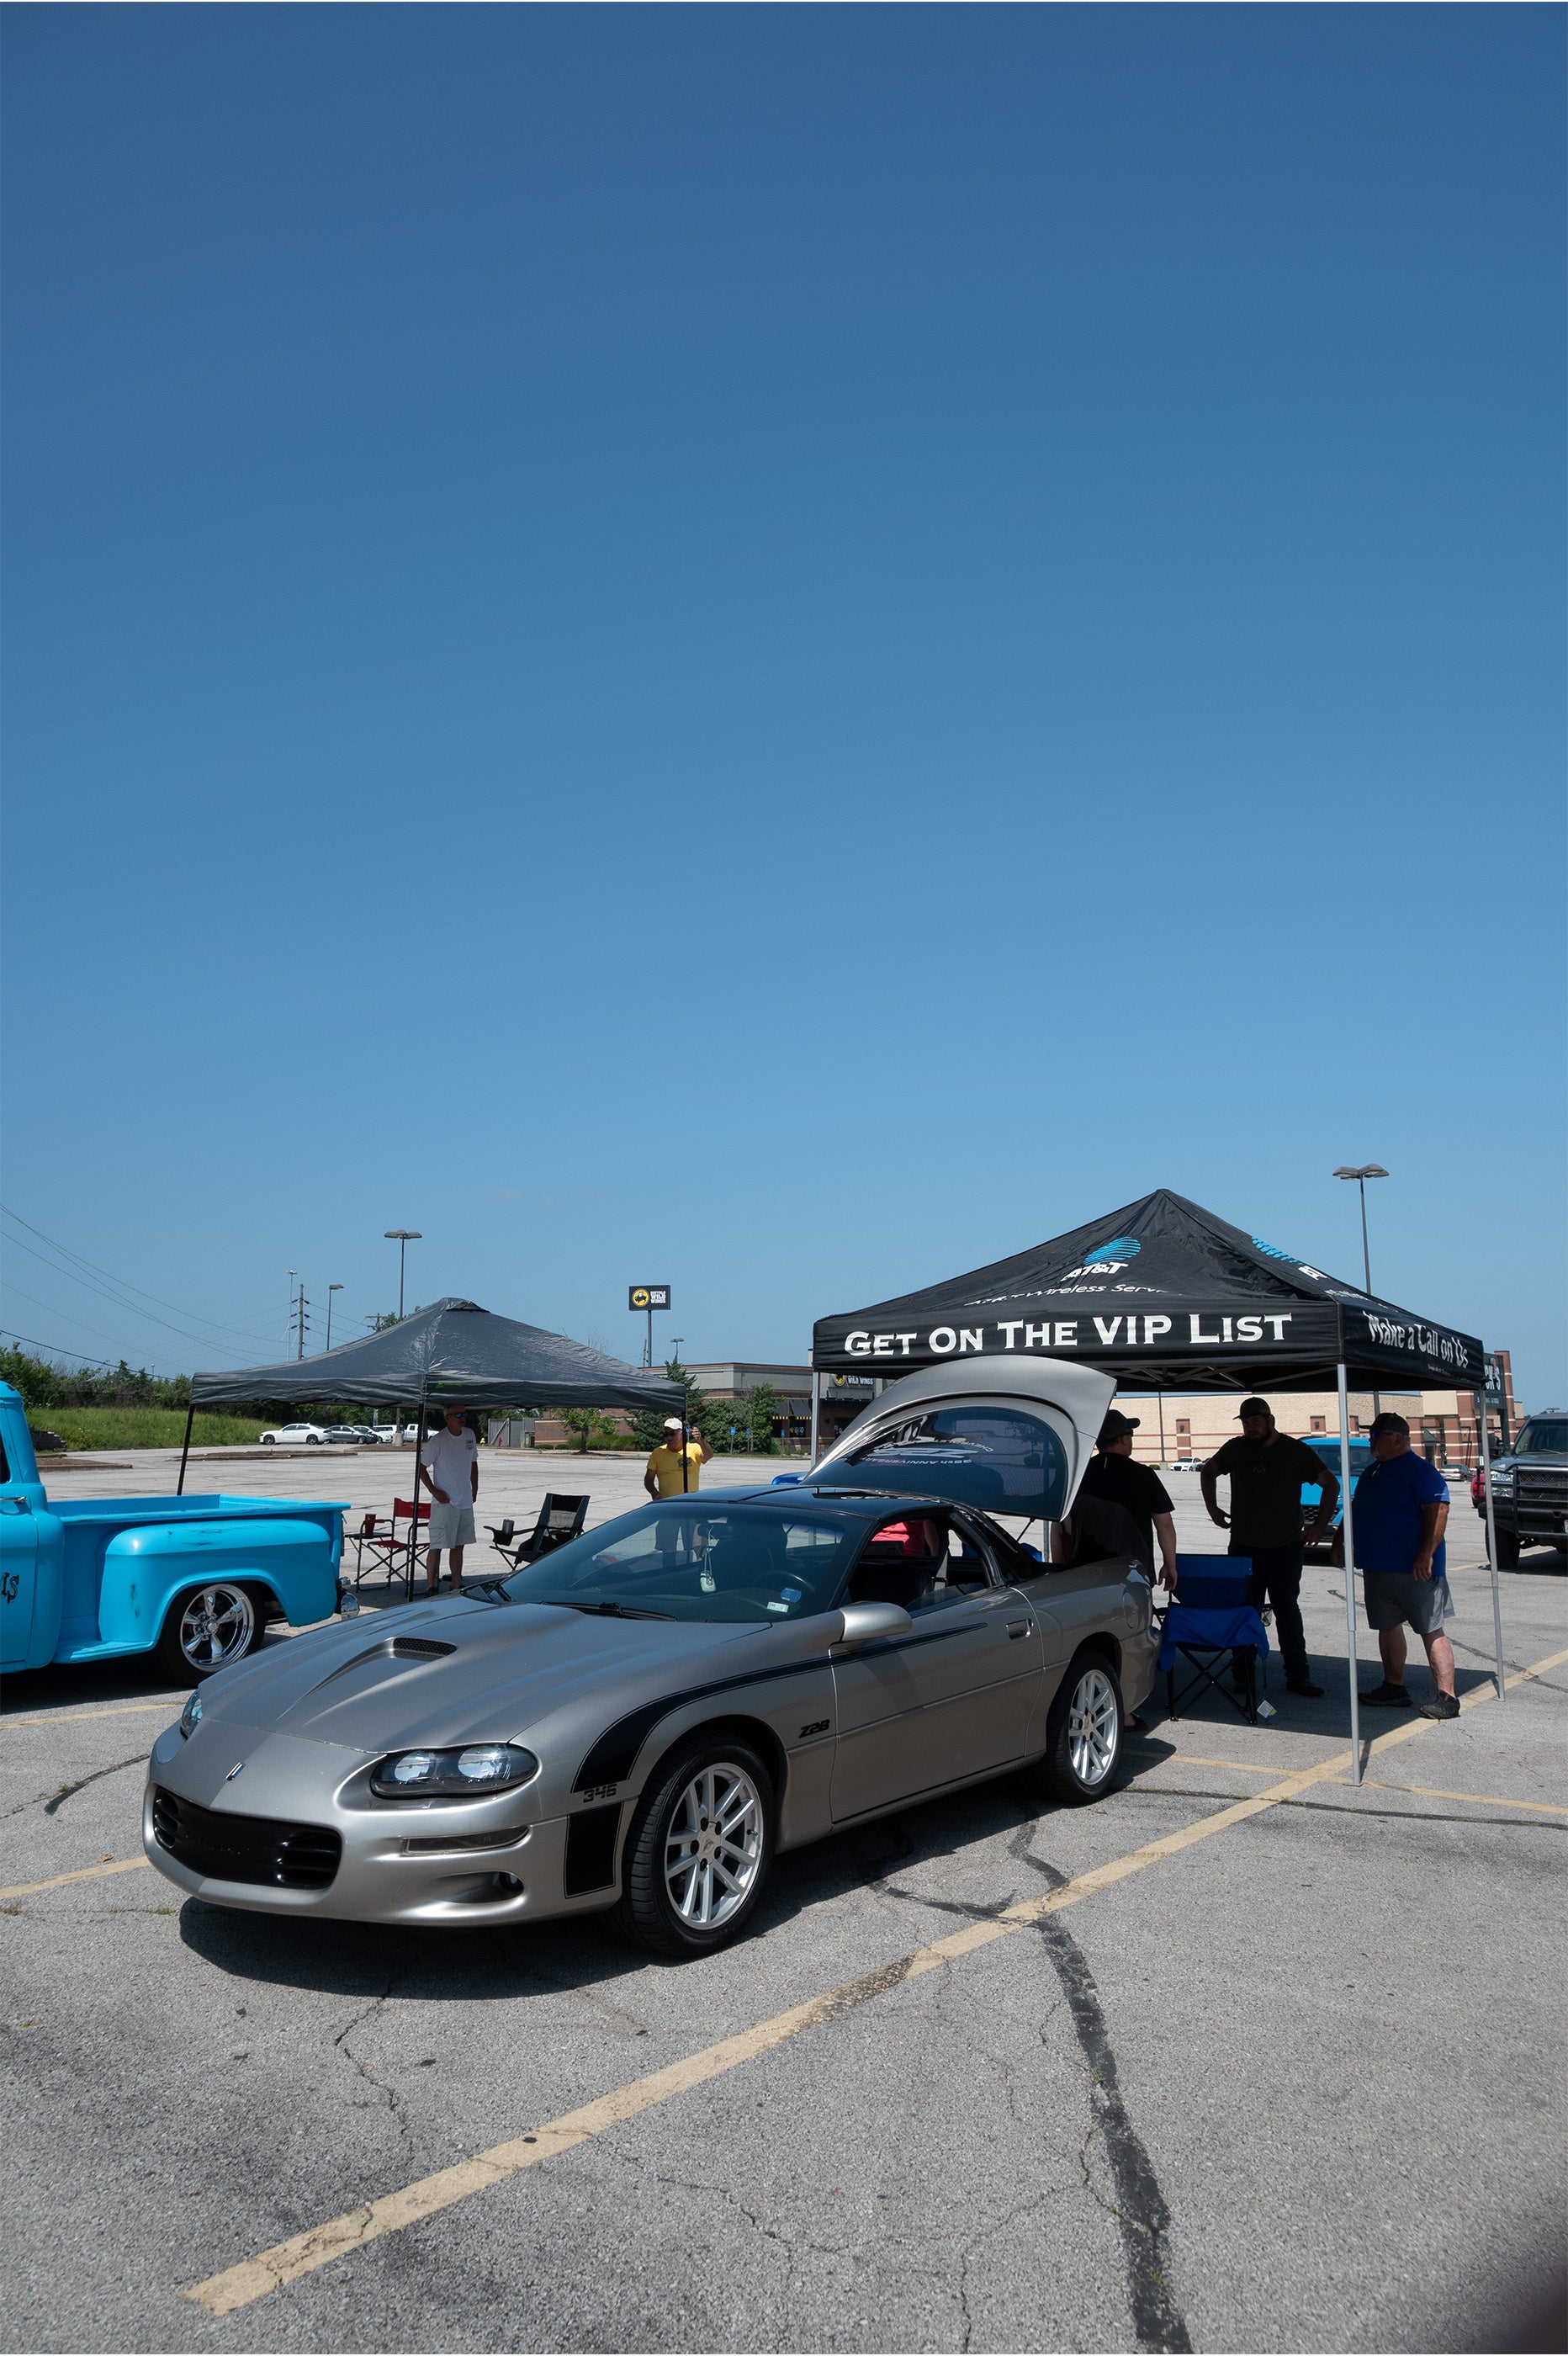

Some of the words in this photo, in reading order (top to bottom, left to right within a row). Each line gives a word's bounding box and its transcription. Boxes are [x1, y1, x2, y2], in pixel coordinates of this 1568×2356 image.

[1060, 1261, 1129, 1281] AT&T
[844, 1330, 918, 1356] GET
[928, 1326, 984, 1354] ON
[997, 1319, 1078, 1349] THE
[1092, 1314, 1173, 1345] VIP
[1189, 1313, 1292, 1344] LIST
[1363, 1310, 1406, 1349] Make
[1407, 1327, 1415, 1350] a
[1414, 1324, 1439, 1357] Call
[1440, 1339, 1454, 1363] on
[1451, 1336, 1469, 1369] Us
